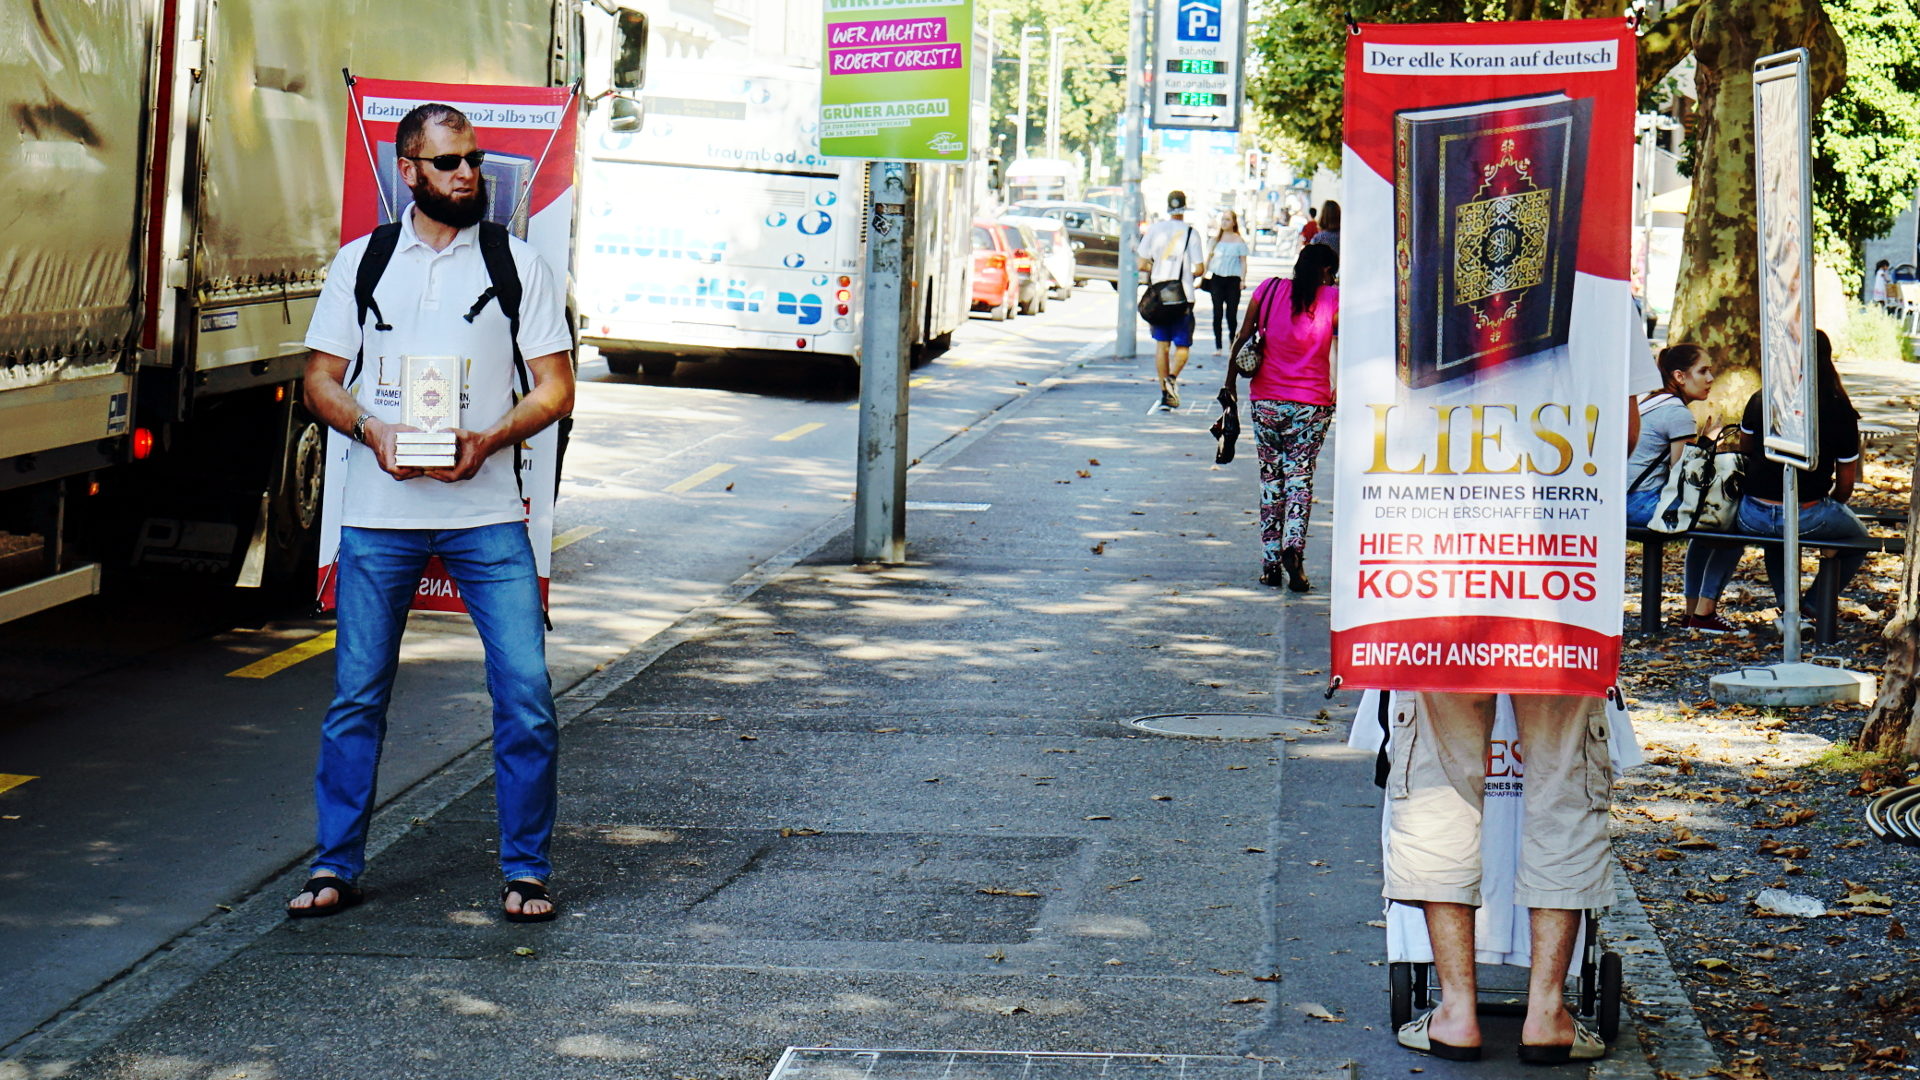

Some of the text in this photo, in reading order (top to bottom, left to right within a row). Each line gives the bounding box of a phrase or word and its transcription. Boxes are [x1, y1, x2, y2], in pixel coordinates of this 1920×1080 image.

[832, 22, 942, 44] WER MACHTS?
[834, 48, 957, 70] ROBERT OBRIST!
[1370, 47, 1612, 68] Der edle Koran auf deutsch
[823, 101, 946, 120] GRÜNER AARGAU
[1362, 402, 1600, 477] LIES!
[1362, 486, 1603, 505] IM NAMEN DEINES HERRN,
[1375, 507, 1590, 520] DER DICH ERSCHAFFEN HAT
[1359, 533, 1597, 558] HIER MITNEHMEN
[1357, 569, 1597, 602] KOSTENLOS
[1351, 643, 1599, 671] EINFACH ANSPRECHEN!
